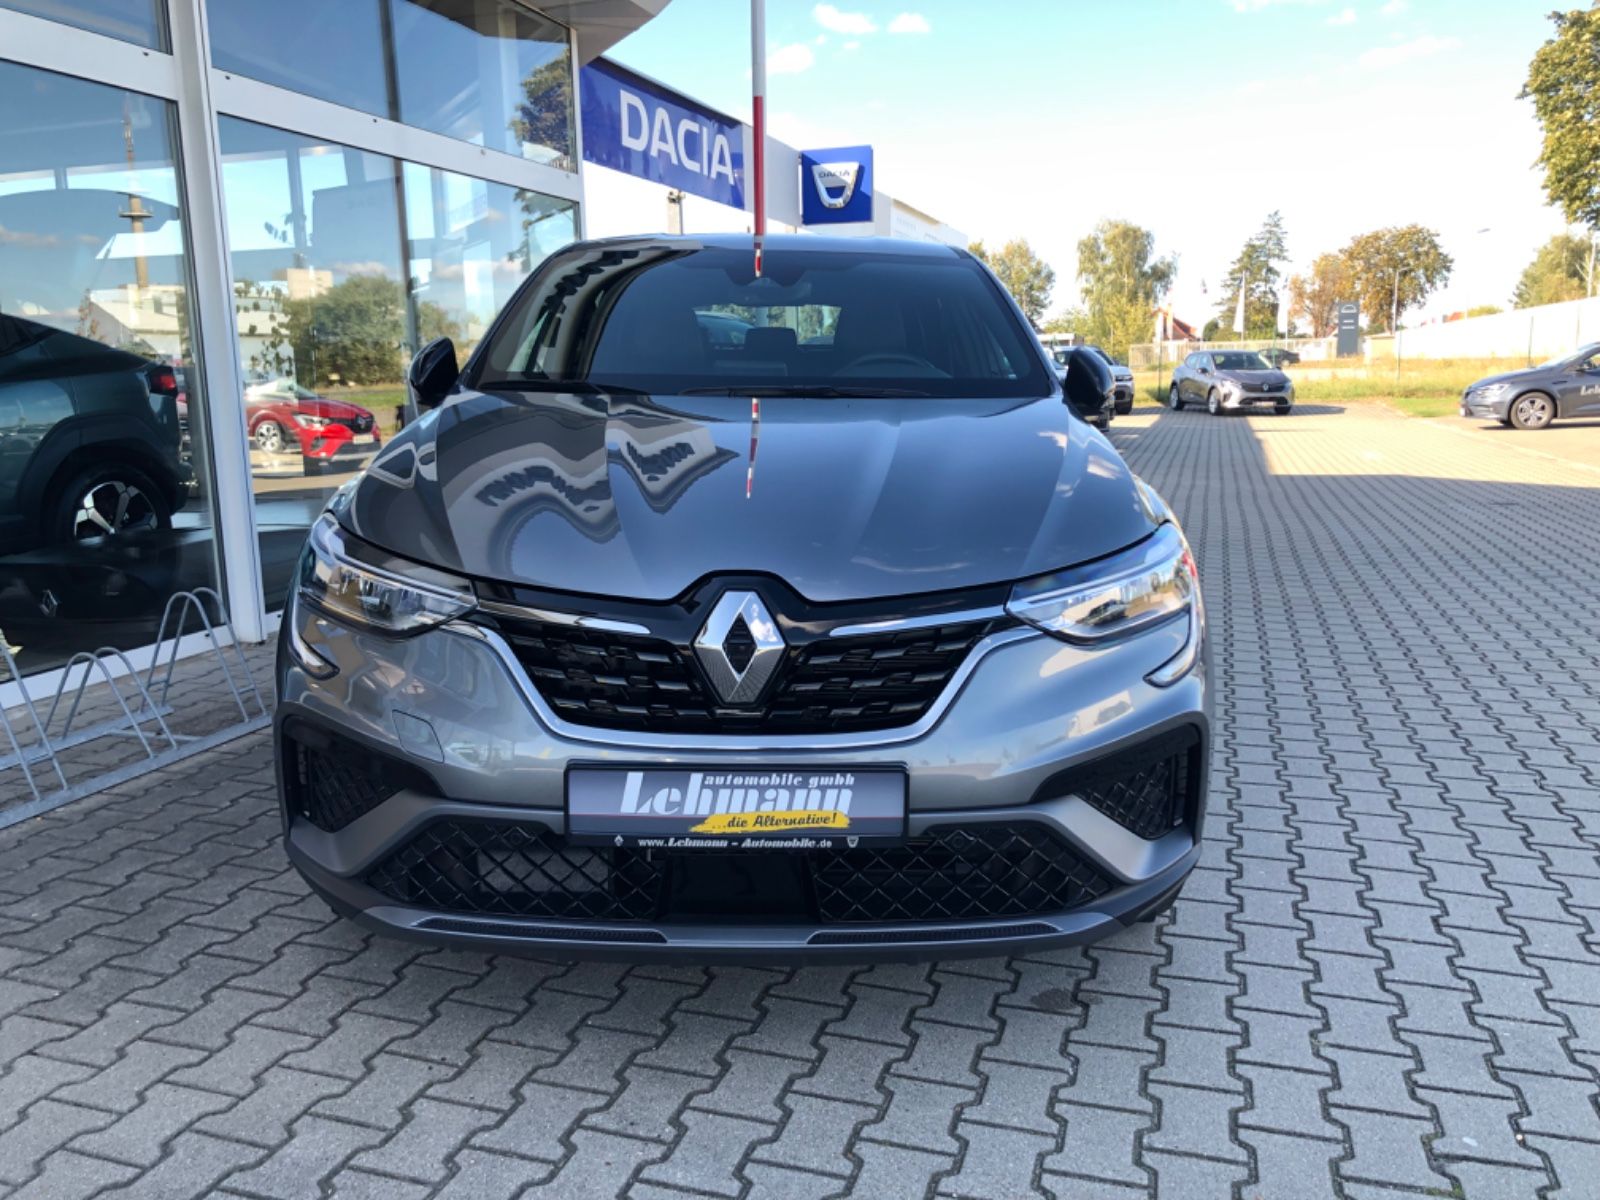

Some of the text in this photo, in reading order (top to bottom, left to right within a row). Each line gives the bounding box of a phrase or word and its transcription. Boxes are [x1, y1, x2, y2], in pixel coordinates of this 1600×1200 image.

[620, 89, 734, 186] DACIA
[620, 771, 853, 815] Lehmann
[704, 773, 855, 788] automobile gmbh
[752, 812, 837, 828] Alternative!
